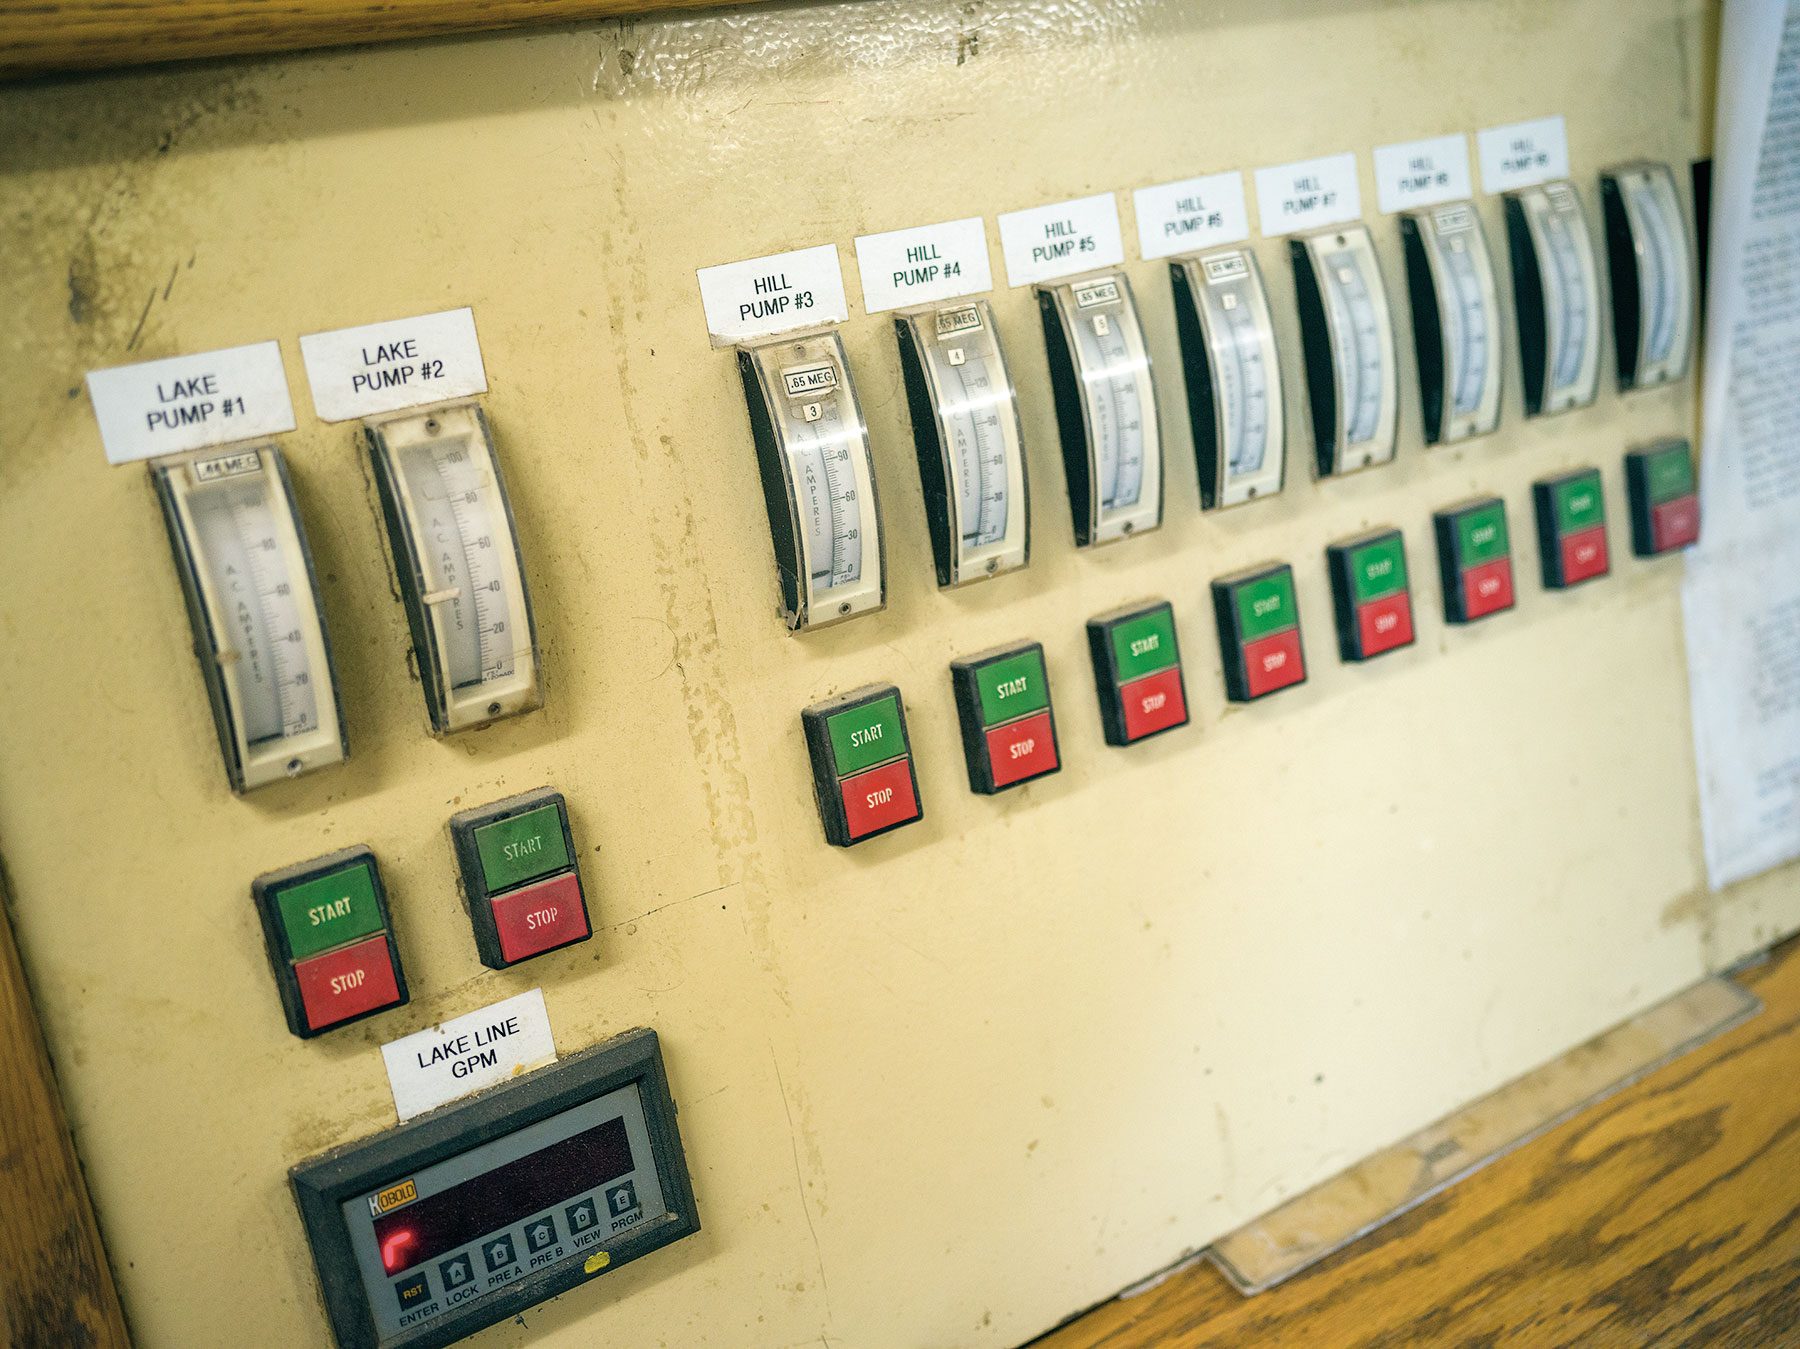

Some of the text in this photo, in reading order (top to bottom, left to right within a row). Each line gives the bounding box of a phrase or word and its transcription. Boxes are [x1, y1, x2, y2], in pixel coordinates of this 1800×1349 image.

[1176, 197, 1205, 214] HILL
[1045, 220, 1077, 239] HILL
[1164, 216, 1203, 237] PUMP
[907, 244, 942, 263] HILL
[1032, 236, 1096, 263] PUMP #5
[754, 273, 792, 295] HILL
[893, 261, 961, 288] PUMP #4
[739, 291, 814, 321] PUMP #3
[953, 313, 976, 326] MEG
[362, 339, 419, 366] LAKE
[955, 351, 960, 360] 4
[352, 360, 445, 393] PUMP #2
[791, 372, 833, 389] .65 MEG
[157, 374, 219, 403] LAKE
[147, 397, 246, 431] PUMP #1
[810, 406, 817, 416] 3
[447, 451, 463, 464] 100
[838, 450, 848, 461] 90
[957, 428, 970, 497] AMPERES
[806, 464, 821, 536] AMPERES
[845, 490, 855, 502] 60
[478, 537, 490, 549] 60
[848, 529, 858, 540] 30
[847, 564, 853, 573] 0
[442, 552, 464, 630] AMPRES
[488, 580, 500, 592] 40
[288, 630, 301, 643] 40
[493, 622, 505, 634] 20
[1130, 633, 1159, 657] START
[496, 660, 502, 670] 0
[295, 673, 308, 686] 20
[997, 676, 1028, 700] START
[1141, 692, 1167, 714] STOP
[300, 713, 307, 725] 0
[850, 723, 884, 748] START
[1009, 739, 1035, 760] STOP
[866, 787, 893, 809] STOP
[503, 835, 542, 861] START
[308, 897, 352, 927] START
[526, 907, 558, 930] STOP
[330, 969, 366, 995] STOP
[417, 1016, 520, 1069] LAKE LINE
[451, 1048, 498, 1079] GPM
[367, 1183, 415, 1216] KOBOLD
[620, 1195, 626, 1205] E
[579, 1214, 587, 1223] D
[611, 1211, 644, 1232] PRGM
[538, 1231, 546, 1240] C
[573, 1229, 601, 1249] VIEW
[497, 1250, 503, 1259] B
[530, 1246, 564, 1269] PRE B
[455, 1269, 462, 1278] A
[487, 1265, 523, 1288] PRE A
[403, 1284, 423, 1300] RST
[446, 1284, 480, 1307] LOCK
[399, 1302, 440, 1327] ENTER
